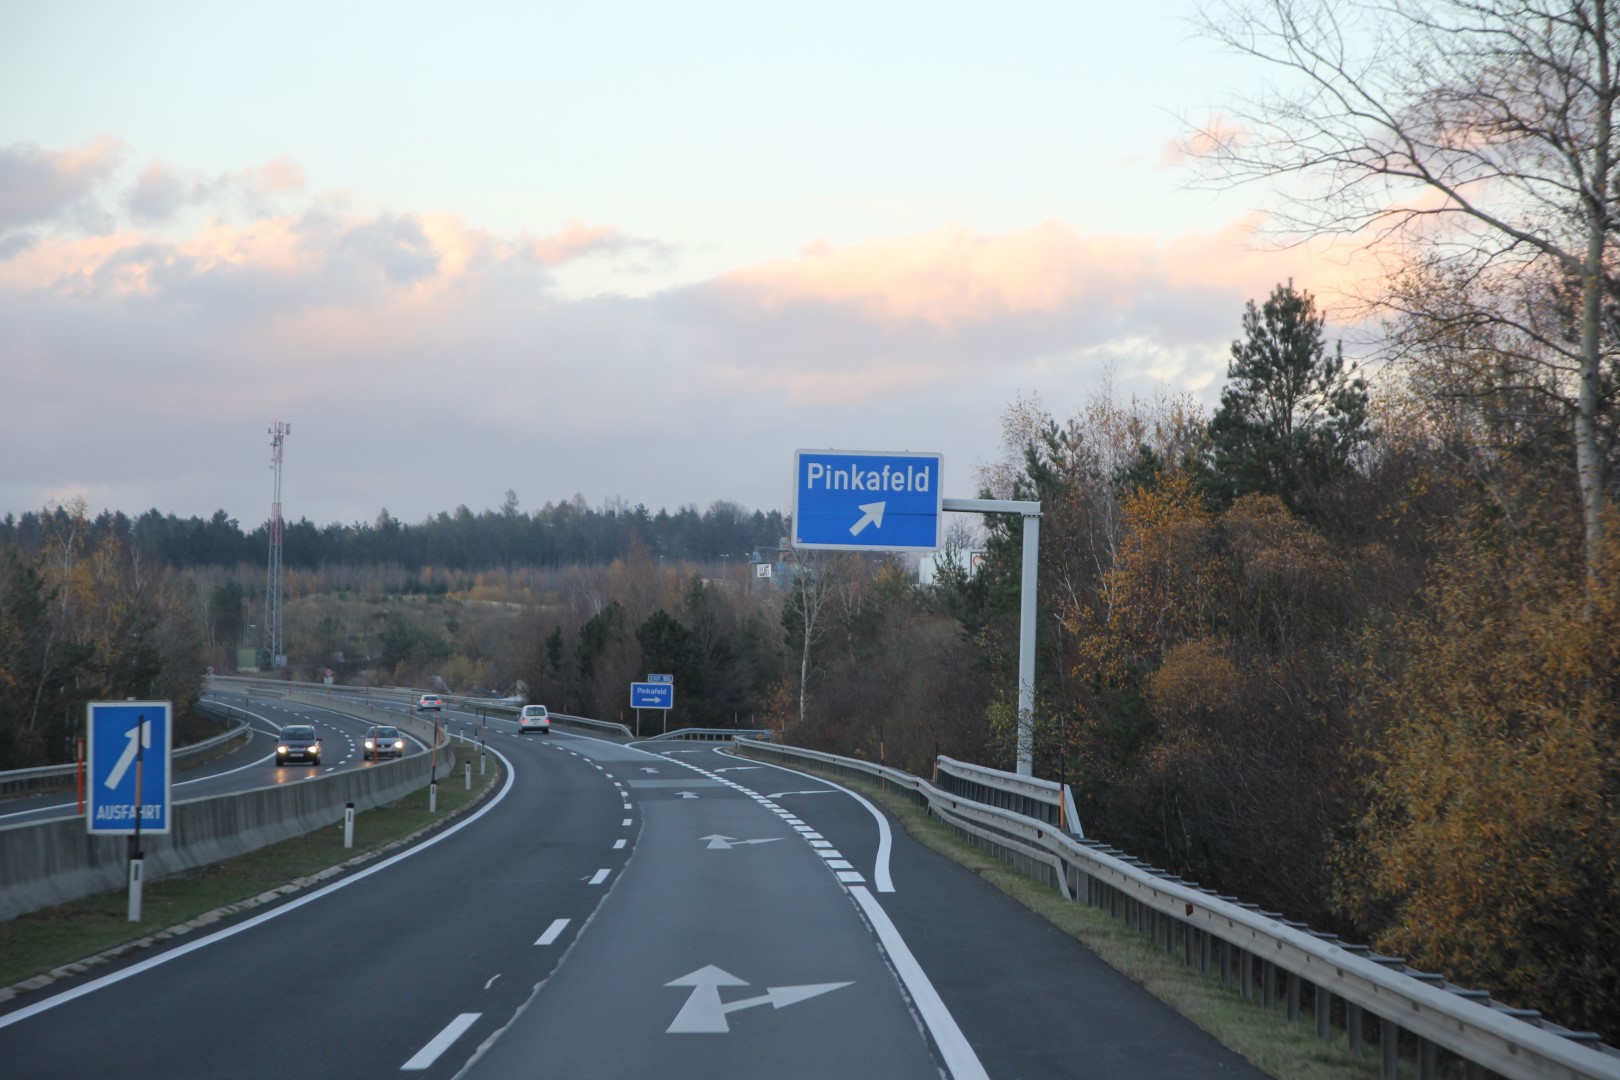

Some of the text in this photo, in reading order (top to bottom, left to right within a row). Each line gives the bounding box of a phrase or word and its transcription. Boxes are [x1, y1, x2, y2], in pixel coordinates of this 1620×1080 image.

[807, 462, 930, 492] Pinkafeld
[637, 687, 667, 695] Pinkafeld
[96, 805, 162, 820] AUSFAHRT
